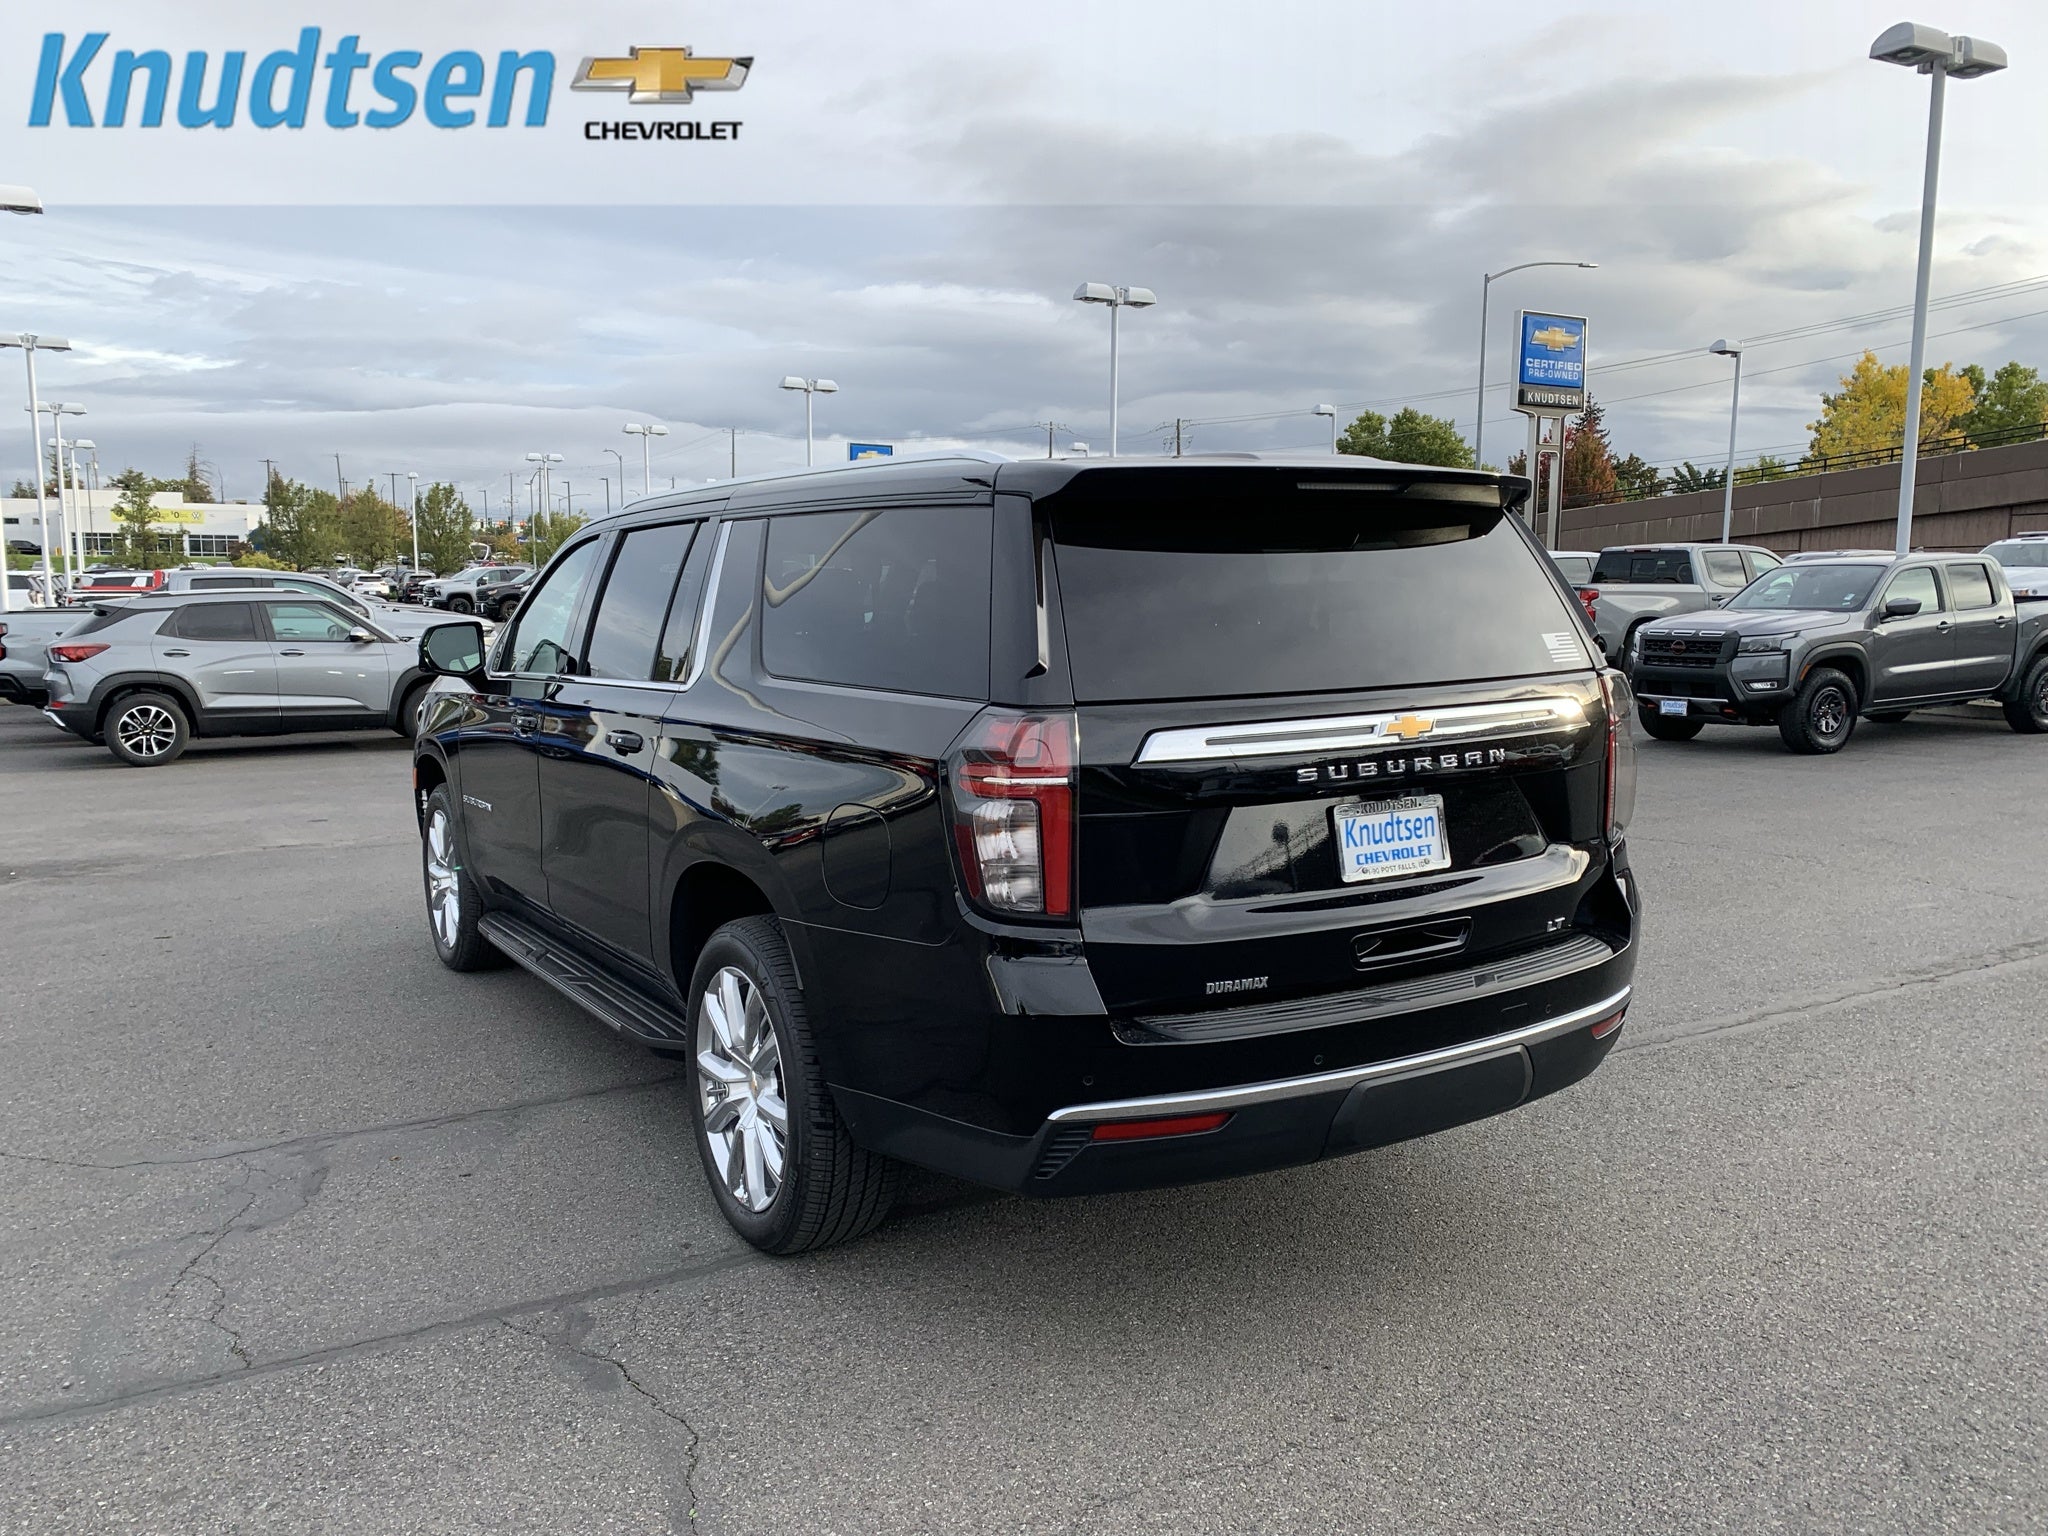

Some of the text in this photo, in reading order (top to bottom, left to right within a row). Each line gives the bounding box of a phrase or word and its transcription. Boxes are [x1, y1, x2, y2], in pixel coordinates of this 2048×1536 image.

[1526, 358, 1582, 371] CERTIFIED
[1528, 368, 1579, 380] PRE-OWNED
[1527, 391, 1579, 405] KNUDTSEN
[1296, 748, 1506, 783] SUBURBAN
[1360, 798, 1418, 814] KNUDTSEN
[1344, 811, 1435, 849] Knudtsen
[1356, 844, 1432, 866] CHEVROLET
[1380, 865, 1397, 874] POST
[1546, 916, 1566, 933] LT
[1205, 976, 1269, 995] DURAMAX
